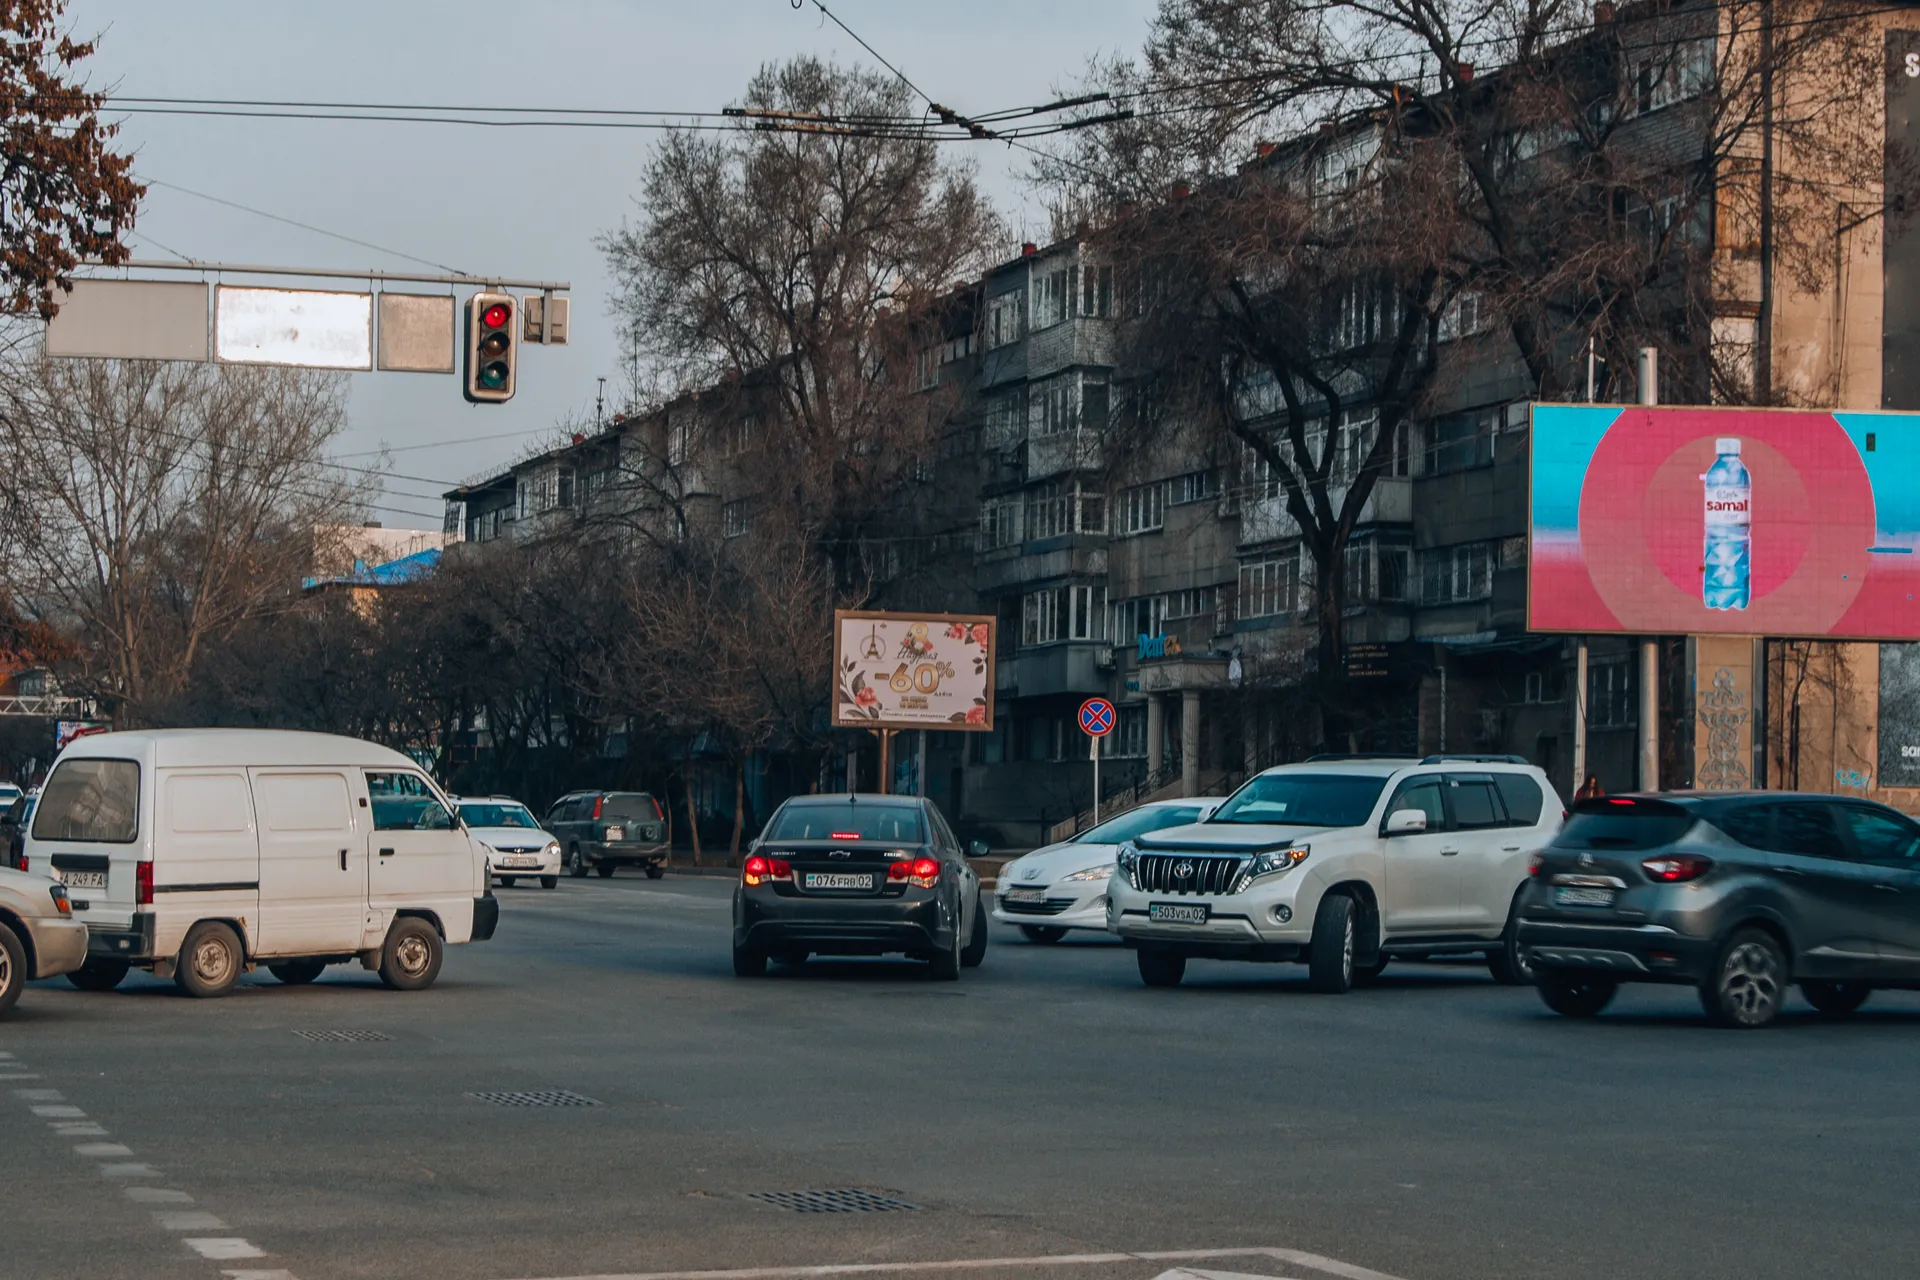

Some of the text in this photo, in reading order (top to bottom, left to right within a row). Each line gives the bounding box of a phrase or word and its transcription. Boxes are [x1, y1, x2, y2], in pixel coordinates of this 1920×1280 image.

[1707, 499, 1748, 512] samal
[874, 661, 956, 695] -60%
[63, 872, 69, 885] A
[72, 872, 88, 886] 249
